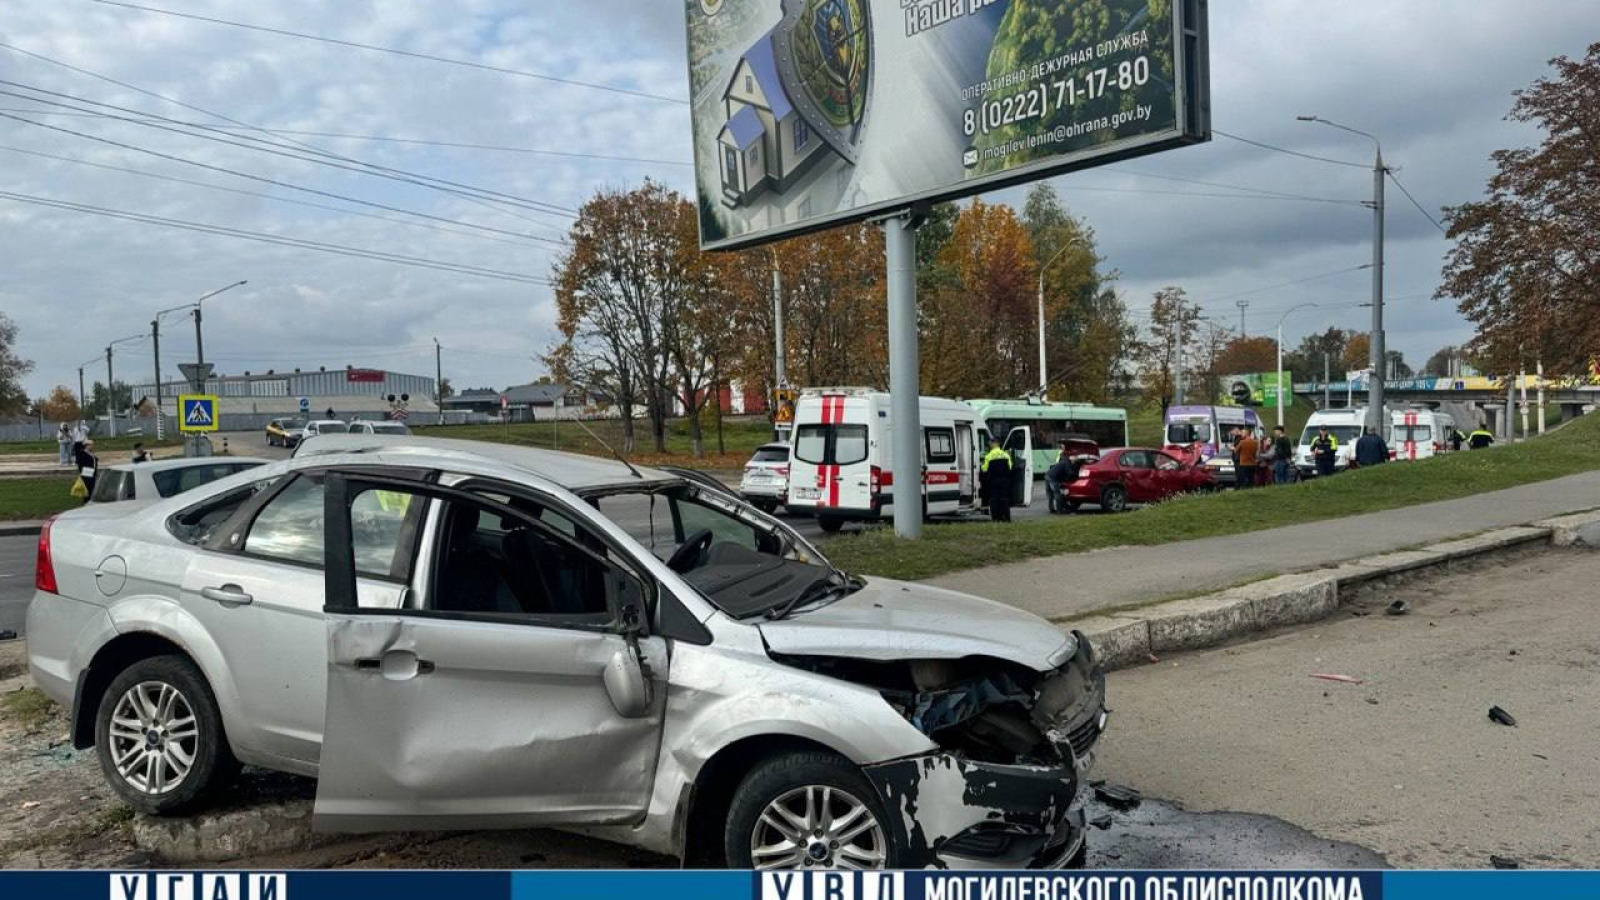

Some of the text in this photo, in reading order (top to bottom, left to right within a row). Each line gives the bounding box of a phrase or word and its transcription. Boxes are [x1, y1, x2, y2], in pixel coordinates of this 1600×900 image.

[906, 0, 965, 36] Наша
[961, 29, 1149, 101] ОПЕРАТИВНО-ДЕЖУРНАЯ СЛУЖБА
[964, 55, 1150, 136] 8 (0222) 71-17-80
